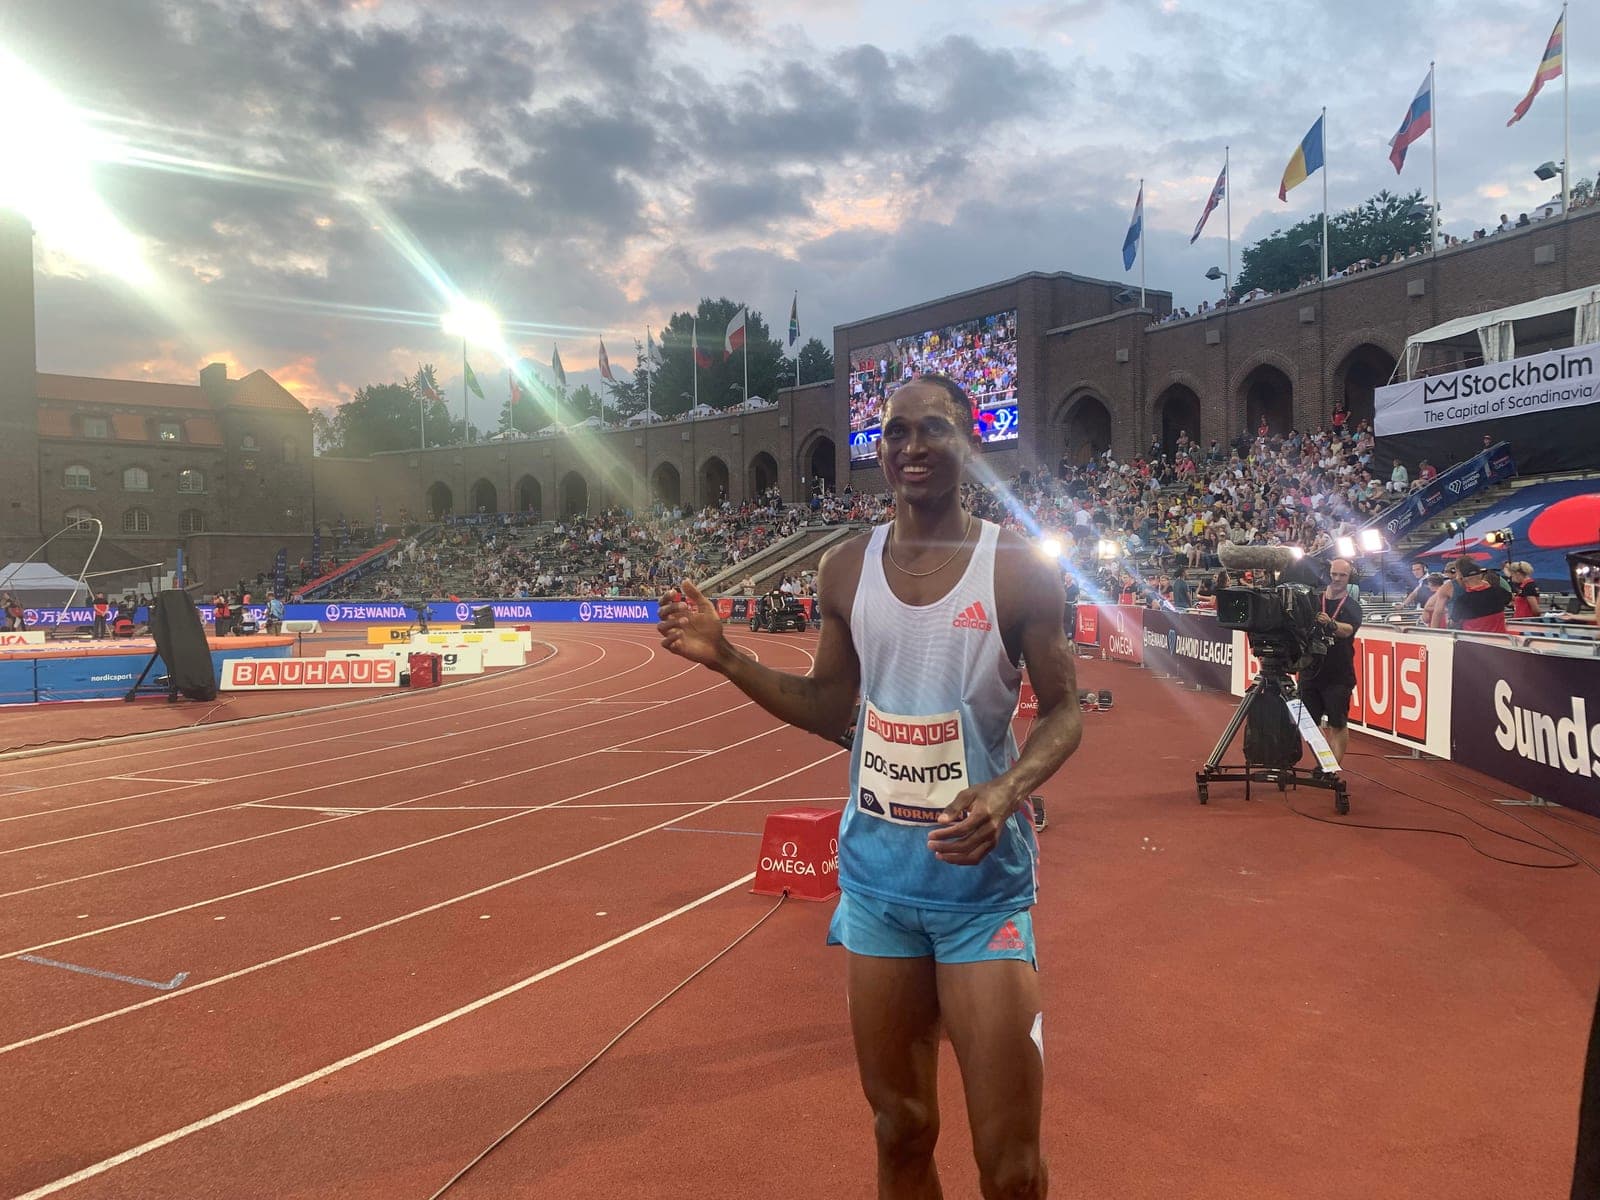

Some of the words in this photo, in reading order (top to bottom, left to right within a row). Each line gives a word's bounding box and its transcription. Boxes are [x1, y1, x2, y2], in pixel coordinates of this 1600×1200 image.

[1461, 354, 1593, 398] Stockholm
[1423, 408, 1444, 423] The
[1446, 403, 1489, 420] Capital
[1491, 400, 1505, 412] of
[1508, 385, 1593, 409] Scandinavia
[953, 617, 992, 631] adidas
[1109, 635, 1134, 656] OMEGA
[1175, 634, 1199, 660] DIAMOND
[1200, 639, 1233, 666] LEAGUE
[91, 673, 132, 682] nordicsport
[235, 661, 393, 683] BAUHAUS
[1020, 702, 1039, 710] OME
[868, 711, 958, 745] BAUHAUS
[864, 751, 888, 776] DOS
[889, 762, 962, 784] SANTOS
[761, 857, 816, 877] OMEGA
[821, 855, 839, 874] OME
